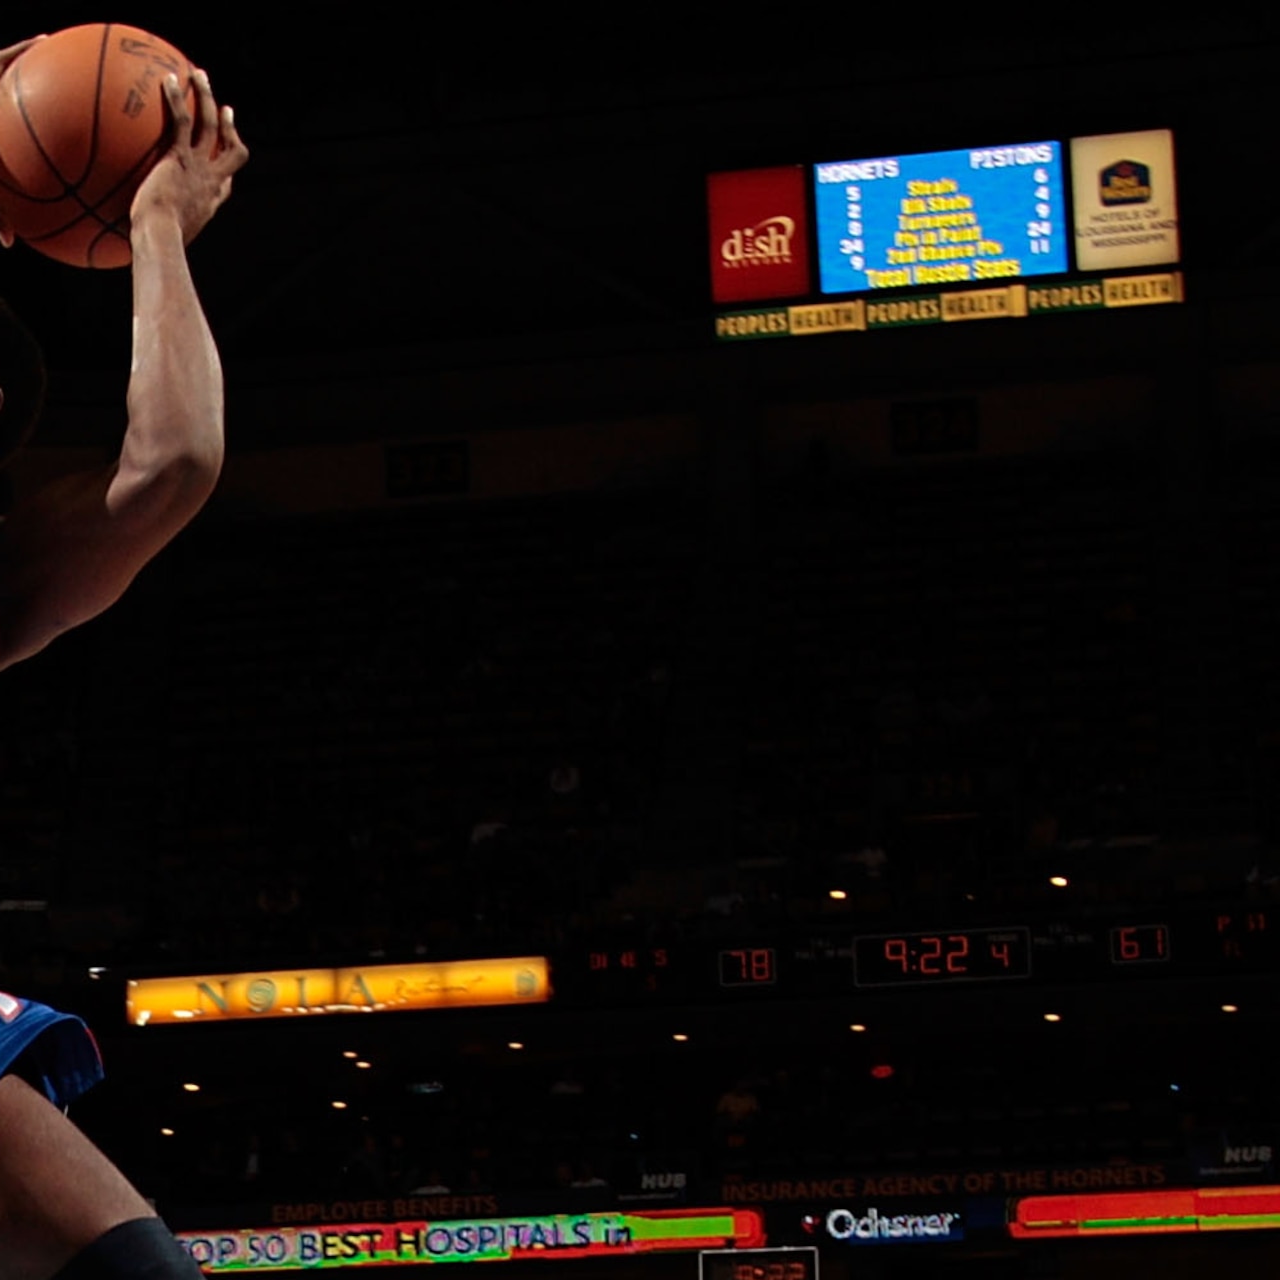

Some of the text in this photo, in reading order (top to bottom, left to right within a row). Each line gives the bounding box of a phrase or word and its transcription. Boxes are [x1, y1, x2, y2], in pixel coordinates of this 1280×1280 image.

[817, 159, 900, 183] HORNETS
[969, 145, 1053, 169] PISTONS
[721, 225, 792, 261] dish
[866, 299, 940, 323] PEOPLES
[1028, 284, 1102, 309] PEOPLES
[715, 313, 788, 337] PEOPLES
[730, 948, 772, 981] 78
[883, 935, 971, 976] 9:22
[990, 943, 1011, 969] 4
[720, 1162, 1167, 1203] INSURANCE AGENCY OF THE HORNETS
[272, 1195, 498, 1225] EMPLOYEE BENEFITS
[825, 1207, 956, 1240] Ochsner
[248, 1235, 285, 1263] 50
[300, 1232, 381, 1261] BEST
[396, 1218, 591, 1258] HOSPITALS
